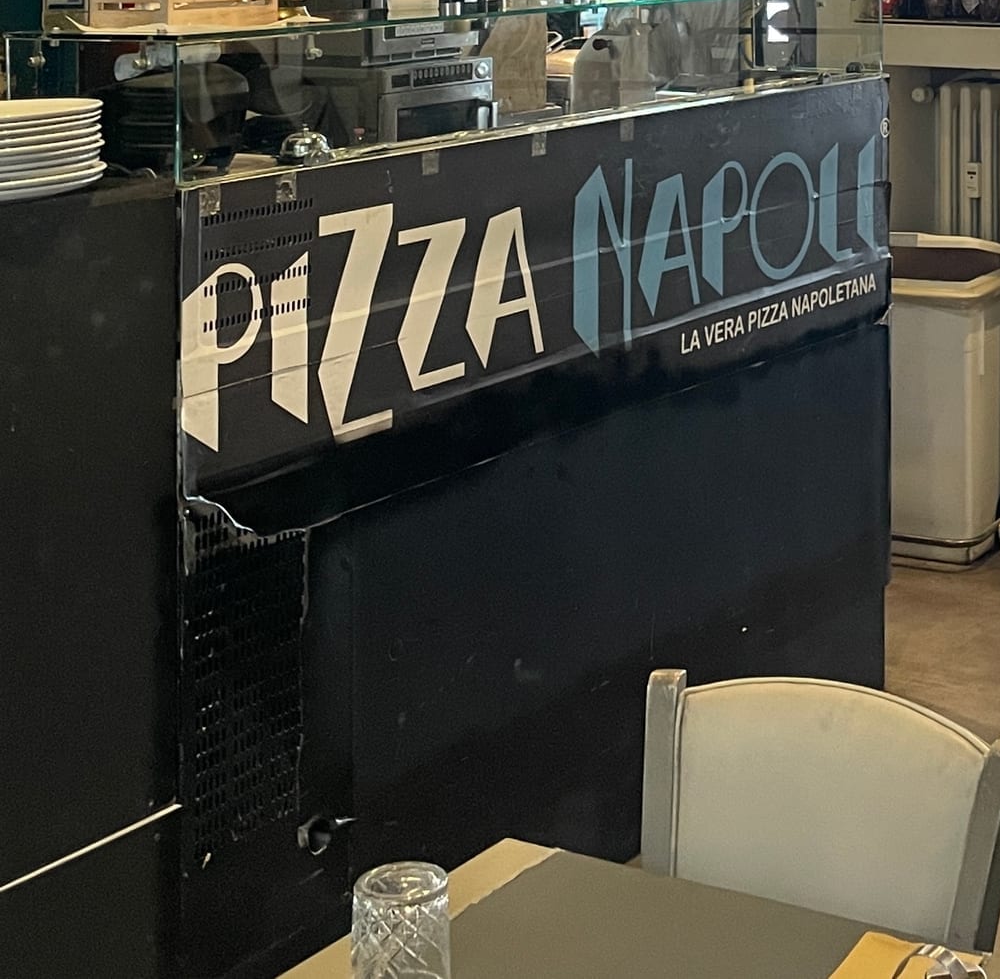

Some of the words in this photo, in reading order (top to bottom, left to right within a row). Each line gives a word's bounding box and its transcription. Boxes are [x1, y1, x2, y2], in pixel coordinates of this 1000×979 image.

[181, 203, 544, 452] PIZZA
[573, 135, 877, 358] NAPOLI
[680, 329, 701, 354] LA
[704, 315, 745, 347] VERA
[747, 300, 789, 333] PIZZA
[791, 273, 877, 317] NAPOLETANA
